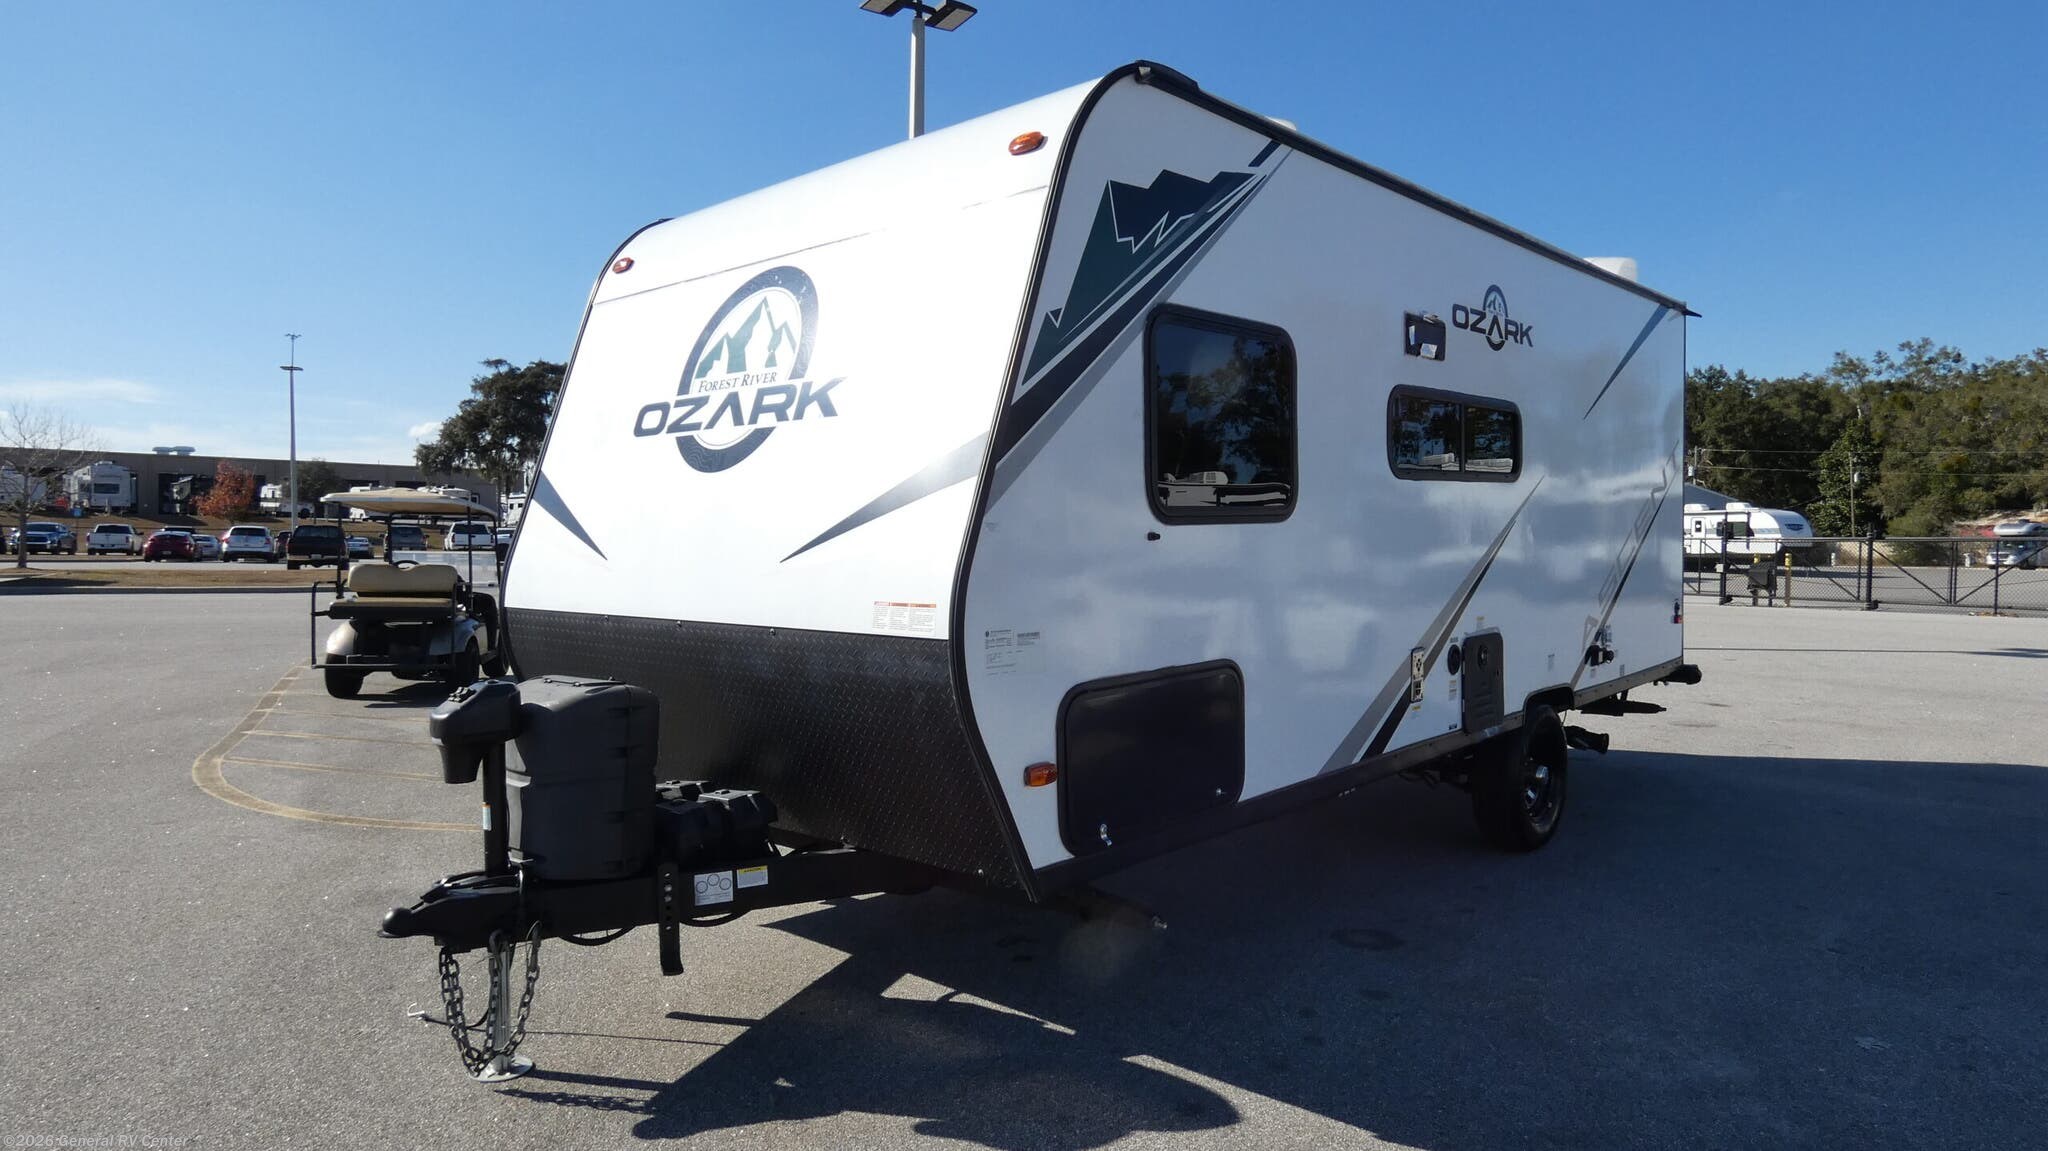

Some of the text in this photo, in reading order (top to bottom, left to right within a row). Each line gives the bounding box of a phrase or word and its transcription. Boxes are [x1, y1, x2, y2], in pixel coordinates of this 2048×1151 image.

[1452, 303, 1534, 348] OZARK
[698, 371, 778, 393] FOREST RIVER
[633, 376, 848, 438] OZARK
